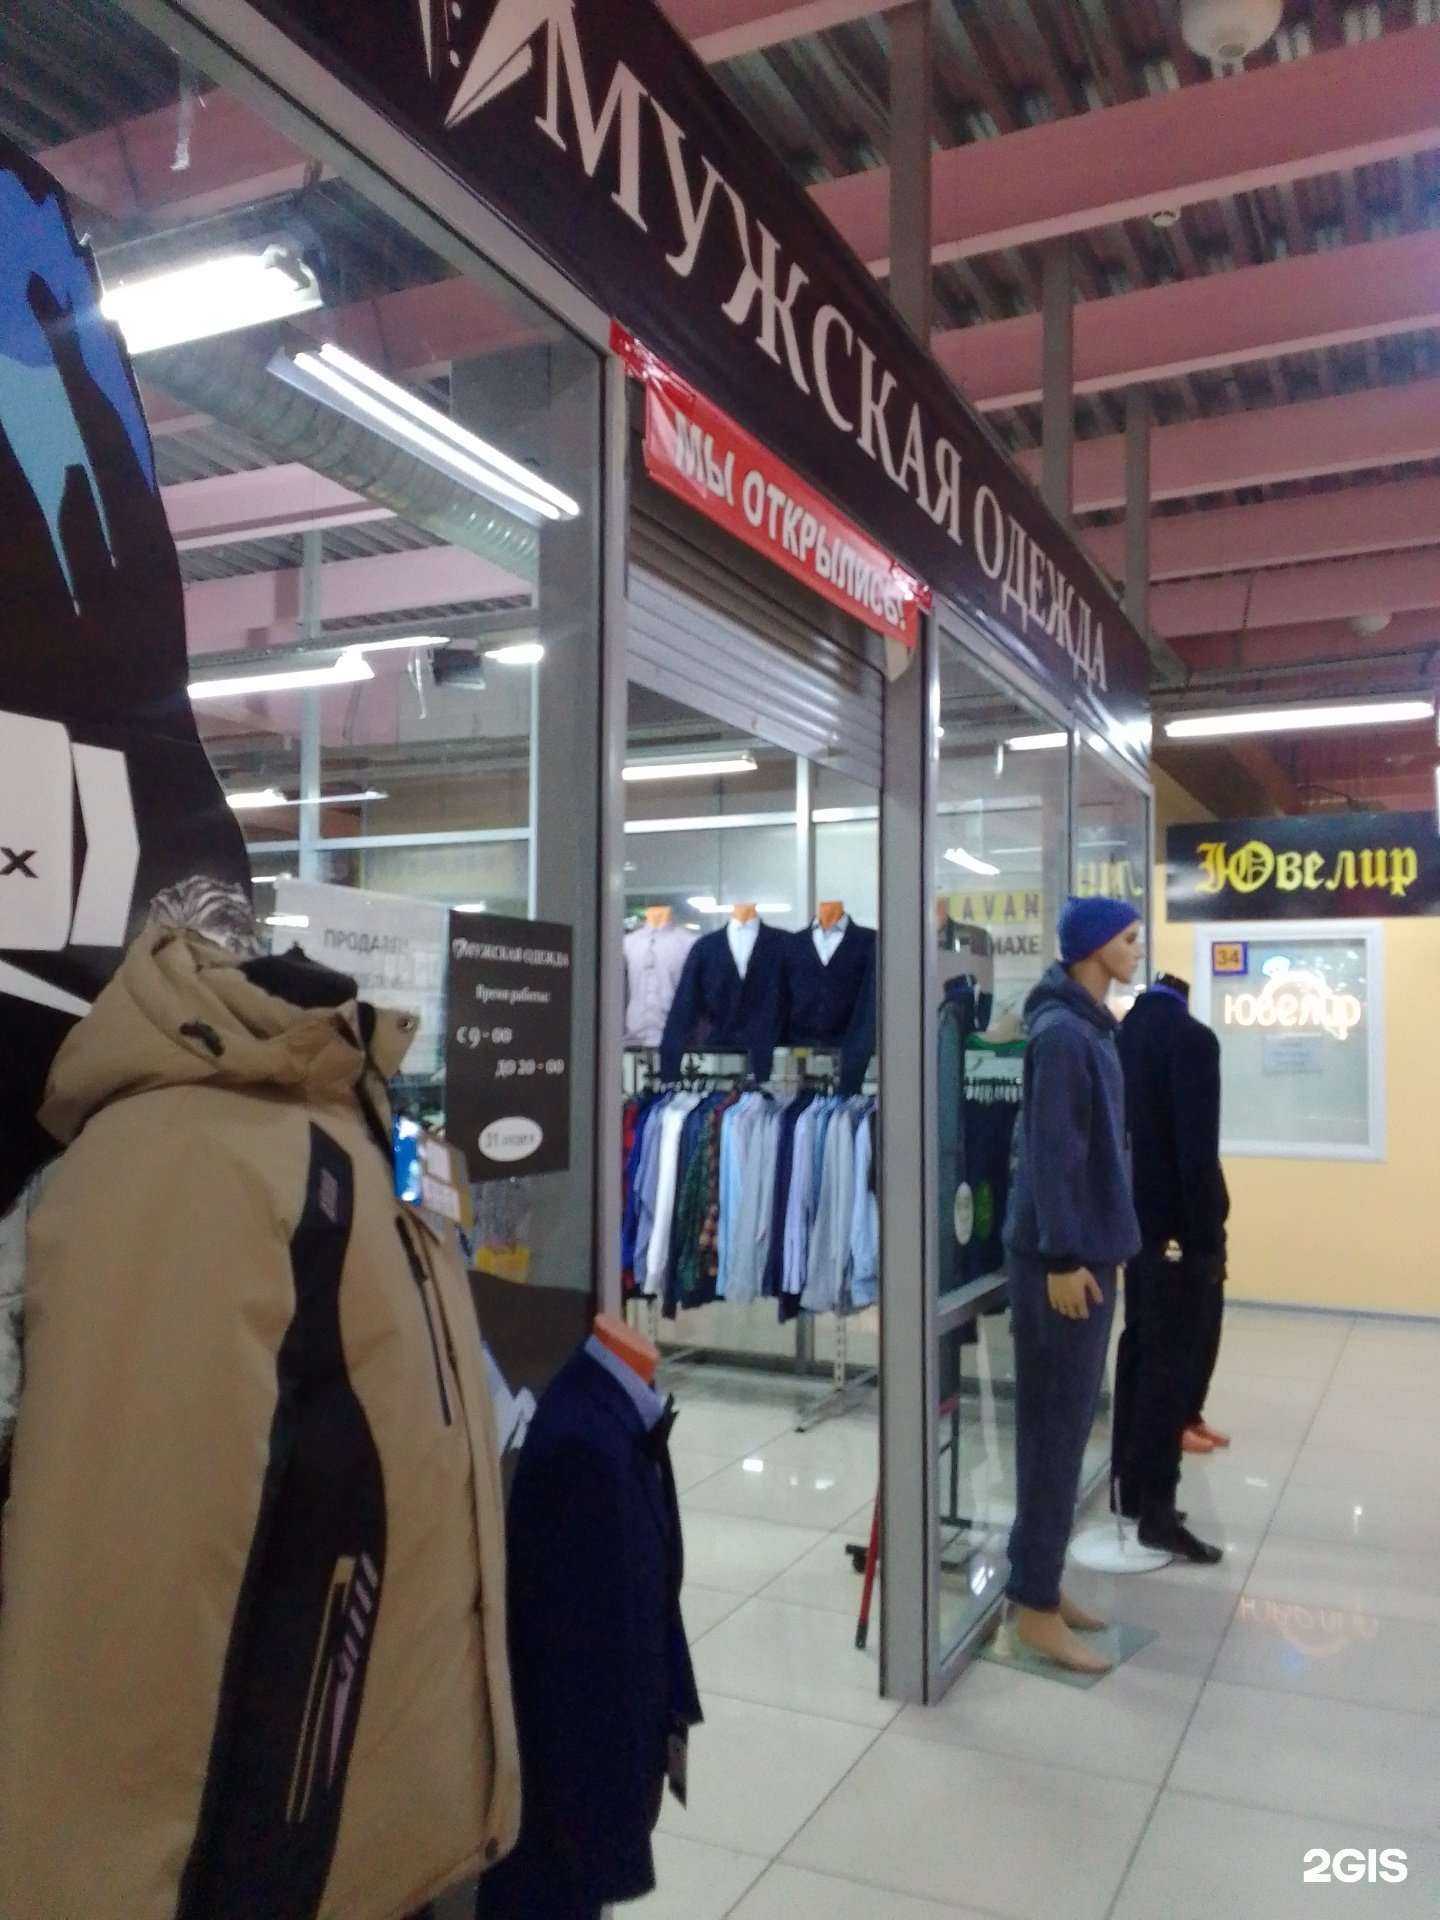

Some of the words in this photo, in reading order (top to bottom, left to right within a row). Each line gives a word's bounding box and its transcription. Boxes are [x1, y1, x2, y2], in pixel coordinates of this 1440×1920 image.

[534, 0, 962, 546] МУЖСКАЯ
[974, 484, 1109, 693] ОДЕЖДА
[673, 409, 736, 505] МЫ
[742, 468, 907, 632] ОТКРЫЛИСЬ!
[1196, 840, 1419, 896] Ювелир
[1218, 950, 1240, 966] 34
